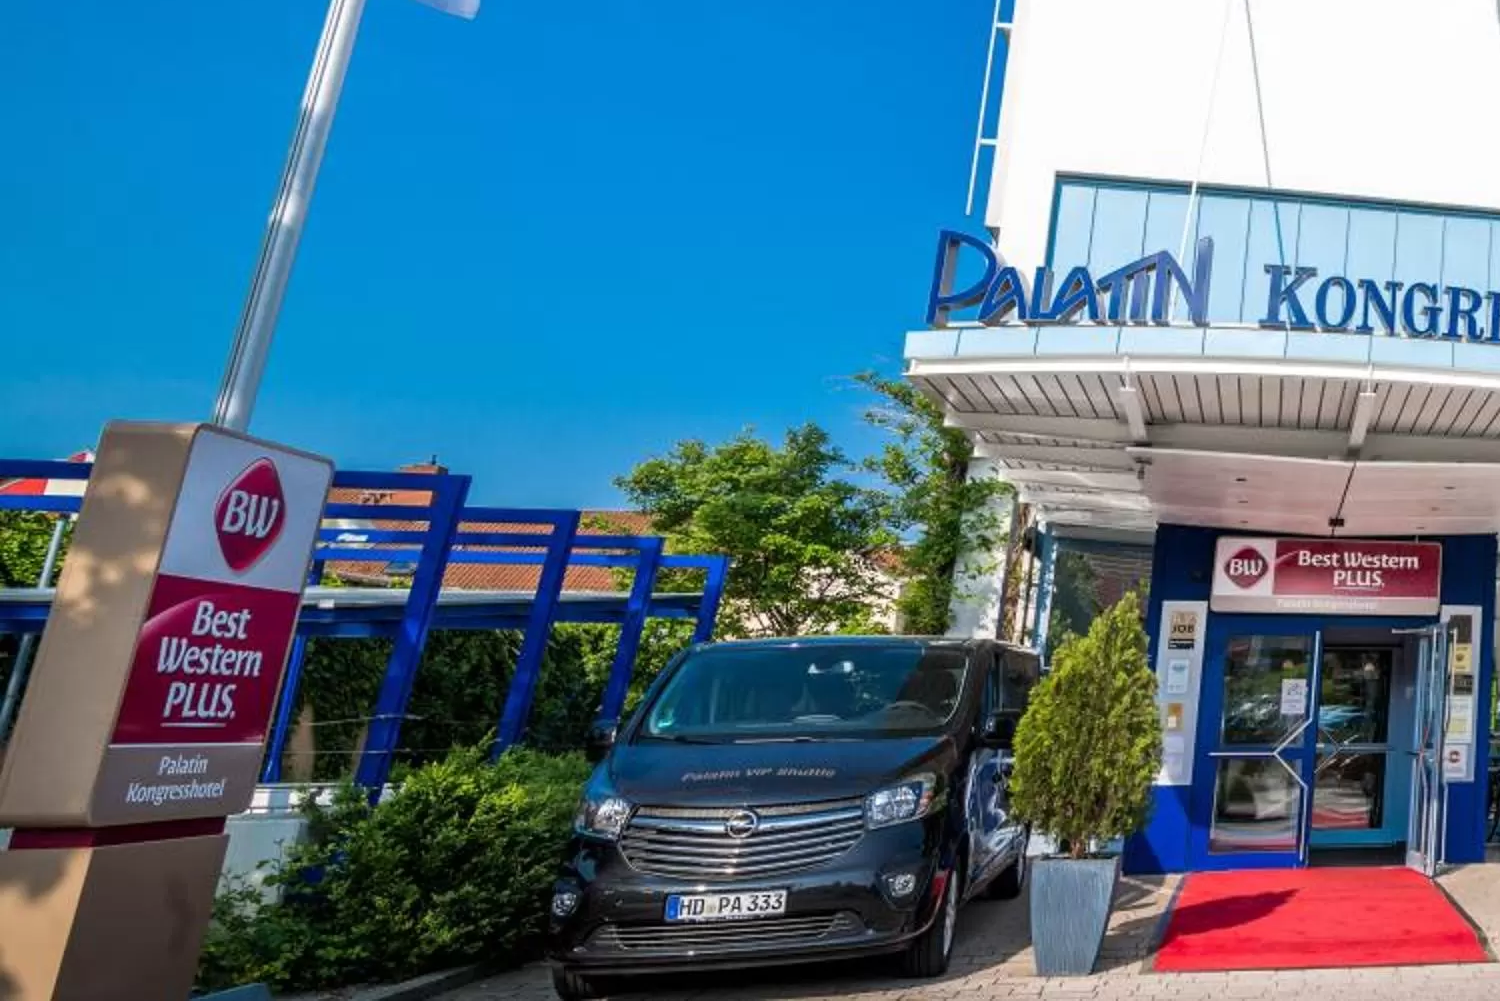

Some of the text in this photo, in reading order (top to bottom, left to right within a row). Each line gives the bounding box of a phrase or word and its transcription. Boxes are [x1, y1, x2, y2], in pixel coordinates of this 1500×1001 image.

[223, 490, 278, 538] BW
[1229, 558, 1263, 576] BW
[1298, 550, 1419, 570] Best Western
[1333, 570, 1383, 587] PLUS
[192, 601, 250, 640] Best
[157, 637, 262, 677] Western
[163, 682, 235, 719] PLUS
[157, 752, 208, 775] Palatin
[125, 778, 228, 806] Kongresshotel
[680, 893, 783, 916] HD PA 333
